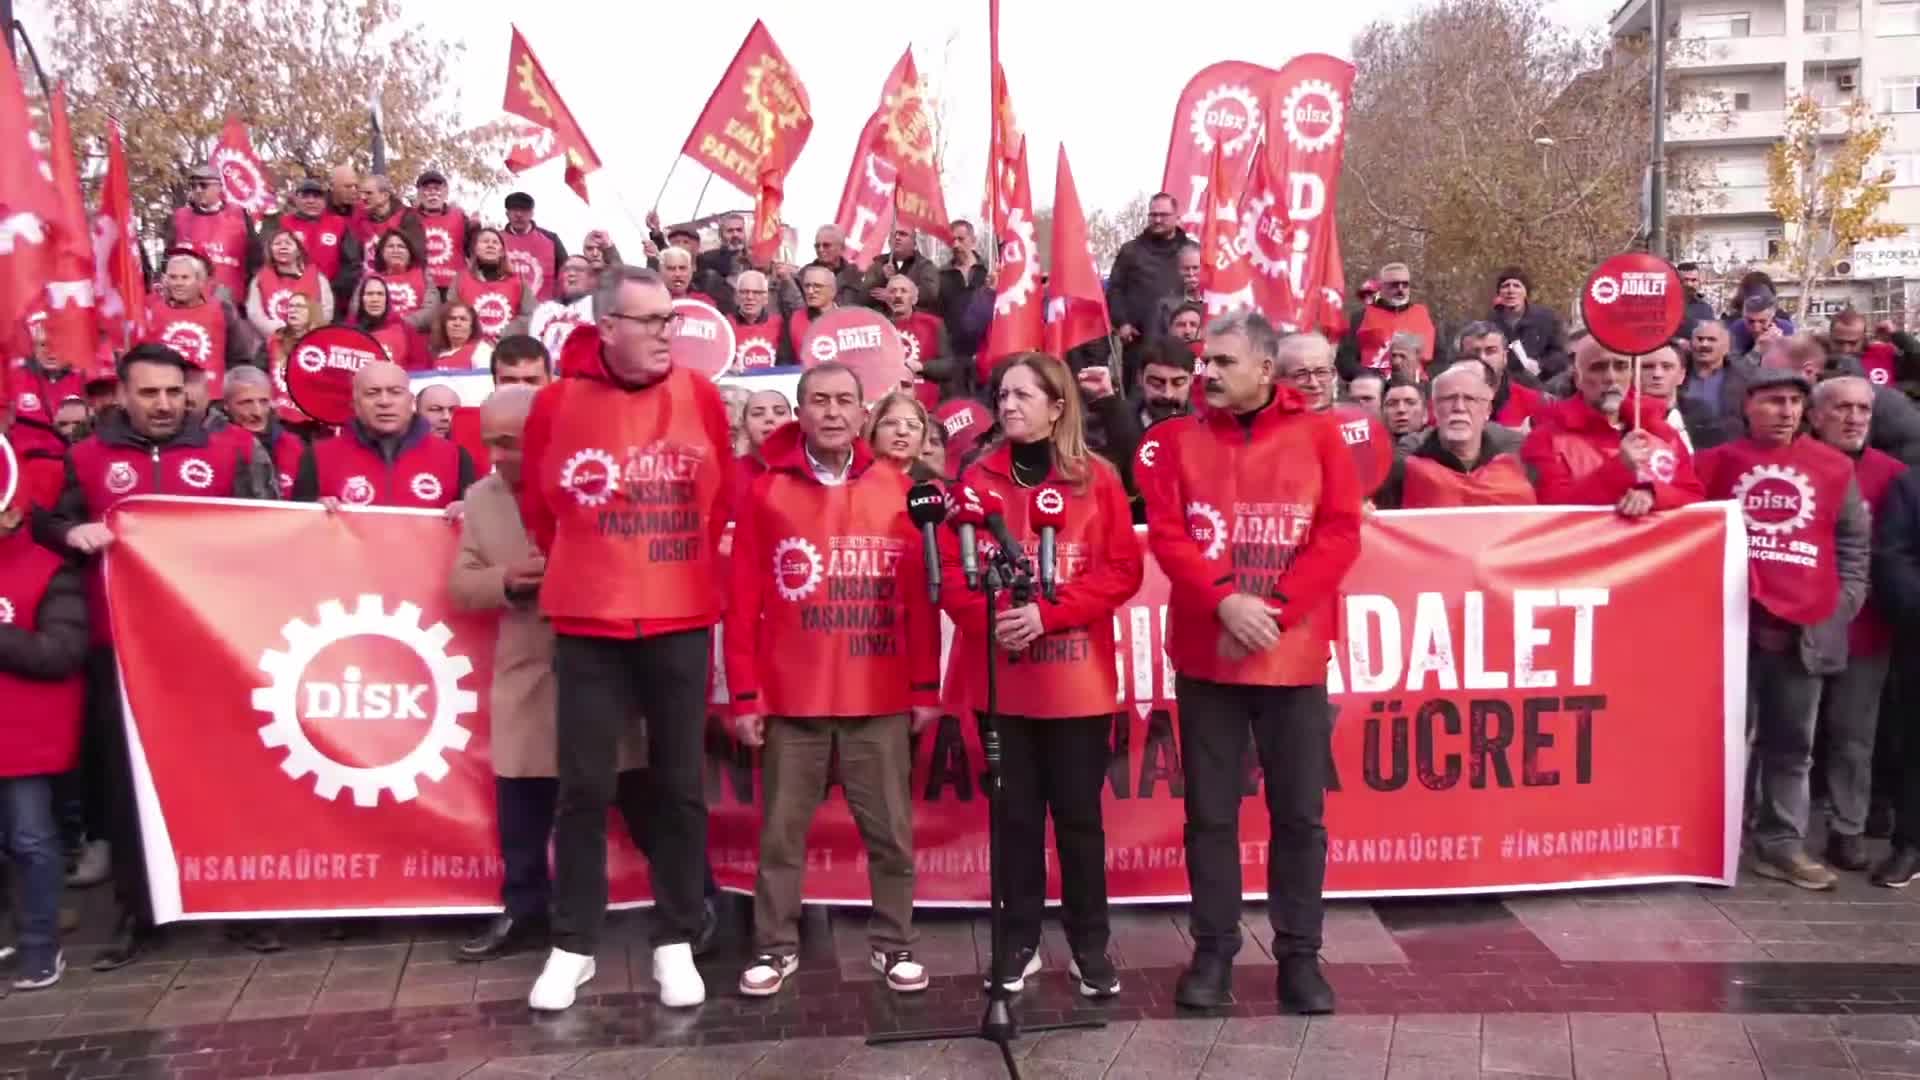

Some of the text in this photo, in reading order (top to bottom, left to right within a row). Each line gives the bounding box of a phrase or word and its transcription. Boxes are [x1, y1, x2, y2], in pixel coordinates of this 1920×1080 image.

[1621, 279, 1665, 296] ADALET
[1744, 489, 1799, 511] DİSK
[303, 665, 428, 720] DİSK
[1362, 694, 1607, 792] ÜCRET
[1326, 832, 1483, 864] SANCAÜCRET
[1500, 824, 1682, 859] #İNSANCAÜCRET
[183, 848, 380, 881] NSANCAÜCRET
